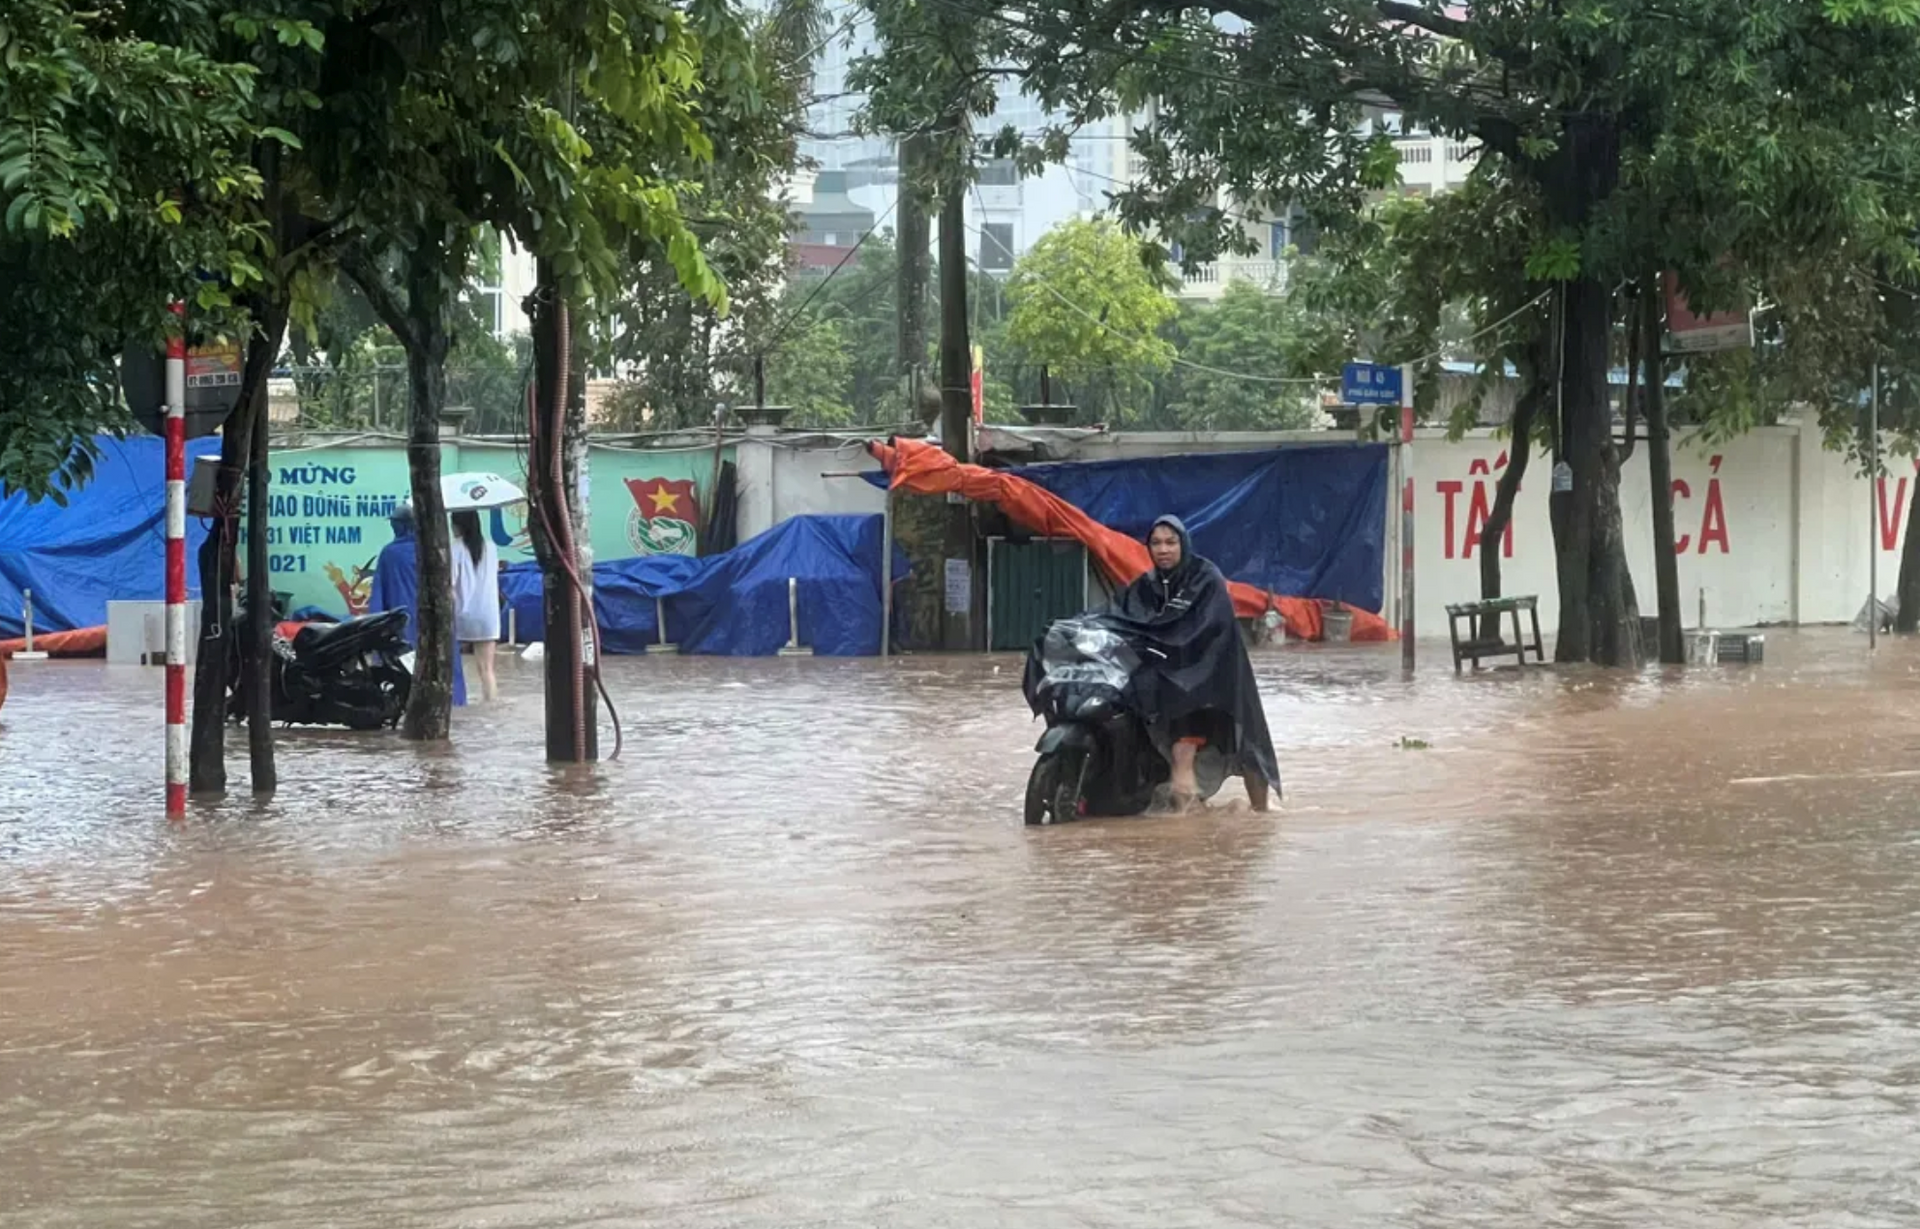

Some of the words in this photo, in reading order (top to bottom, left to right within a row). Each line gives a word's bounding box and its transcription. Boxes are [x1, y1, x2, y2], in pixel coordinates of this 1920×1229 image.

[279, 461, 357, 485] MỪNG
[303, 489, 351, 517] ĐÔNG
[356, 494, 396, 517] NAM
[289, 522, 321, 548] VIỆT
[326, 525, 362, 544] NAM
